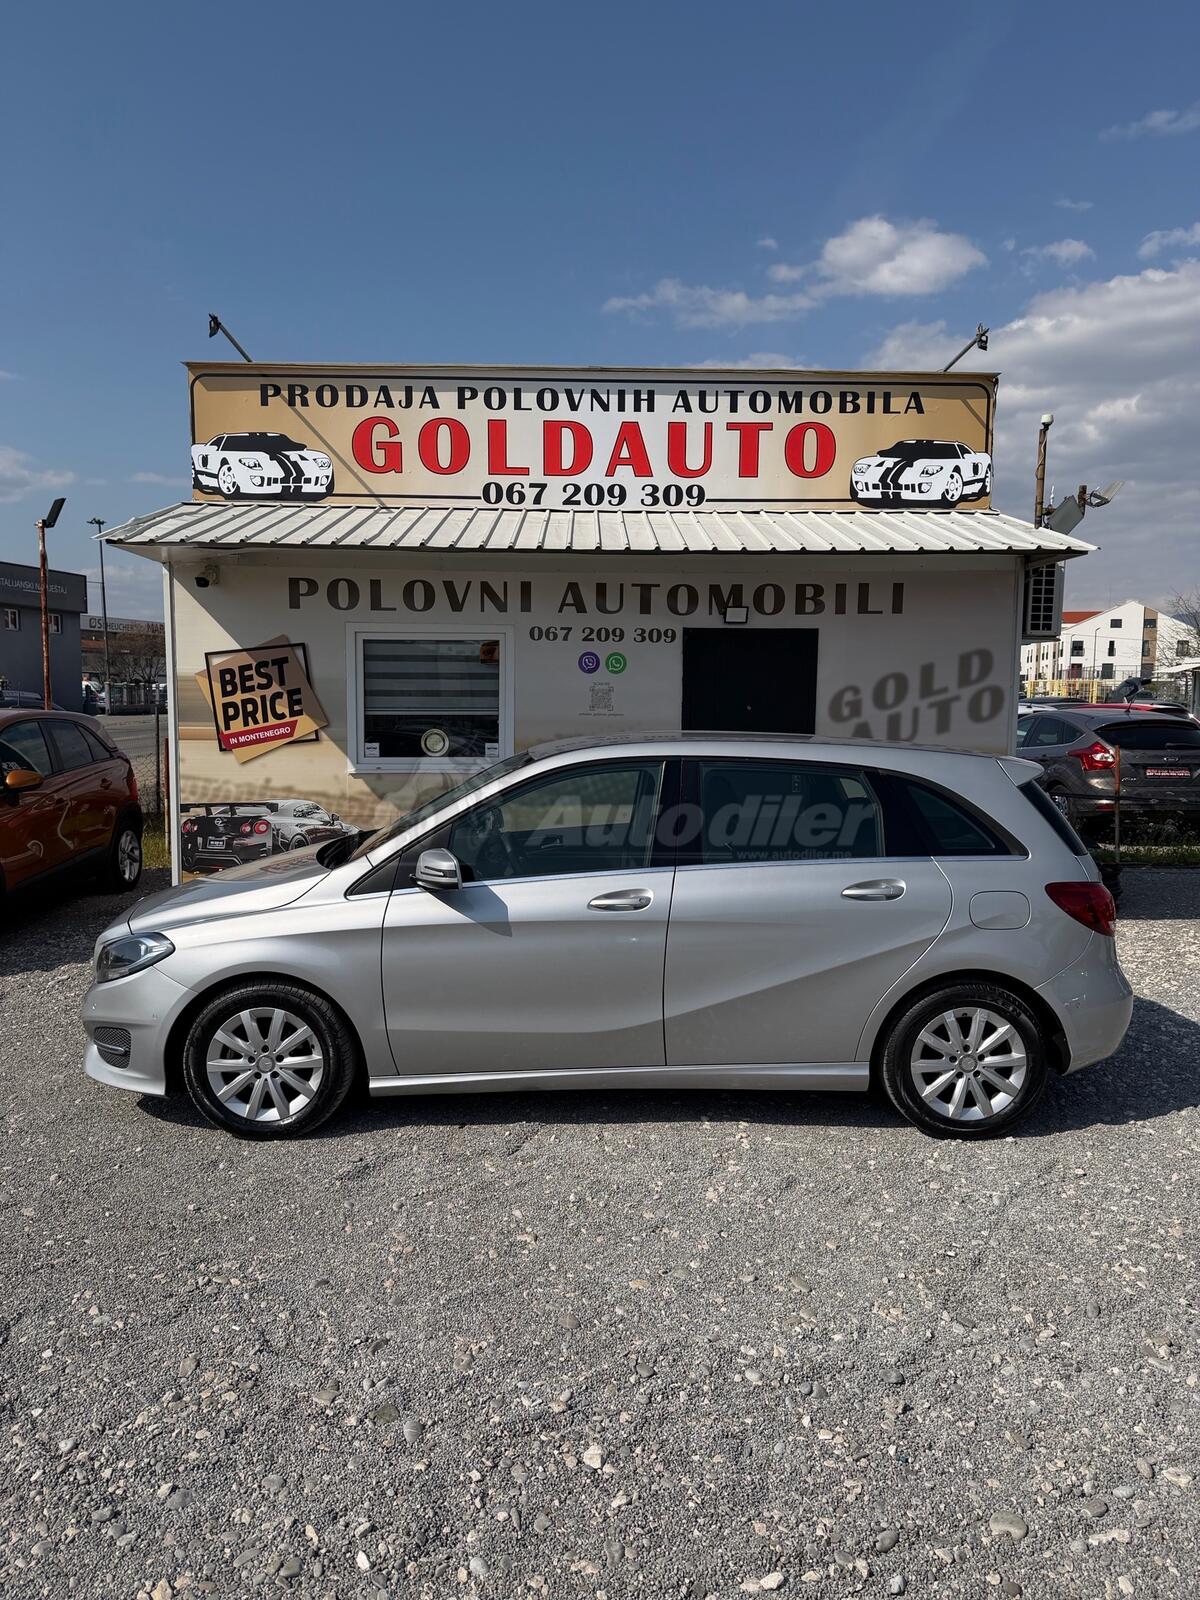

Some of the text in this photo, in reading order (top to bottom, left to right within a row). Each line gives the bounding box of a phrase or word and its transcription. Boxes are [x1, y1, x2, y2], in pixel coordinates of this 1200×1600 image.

[259, 383, 926, 415] PRODAJA POLOVNIH AUTOMOBILA
[351, 415, 838, 479] GOLDAUTO
[482, 481, 706, 507] 067 209 309
[287, 576, 905, 616] POLOVNI AUTOMOBILI
[528, 626, 677, 644] 067 209 309
[218, 656, 289, 698] BEST
[828, 647, 994, 724] GOLD
[221, 687, 304, 731] PRICE
[229, 726, 291, 745] IN MONTENEGRO
